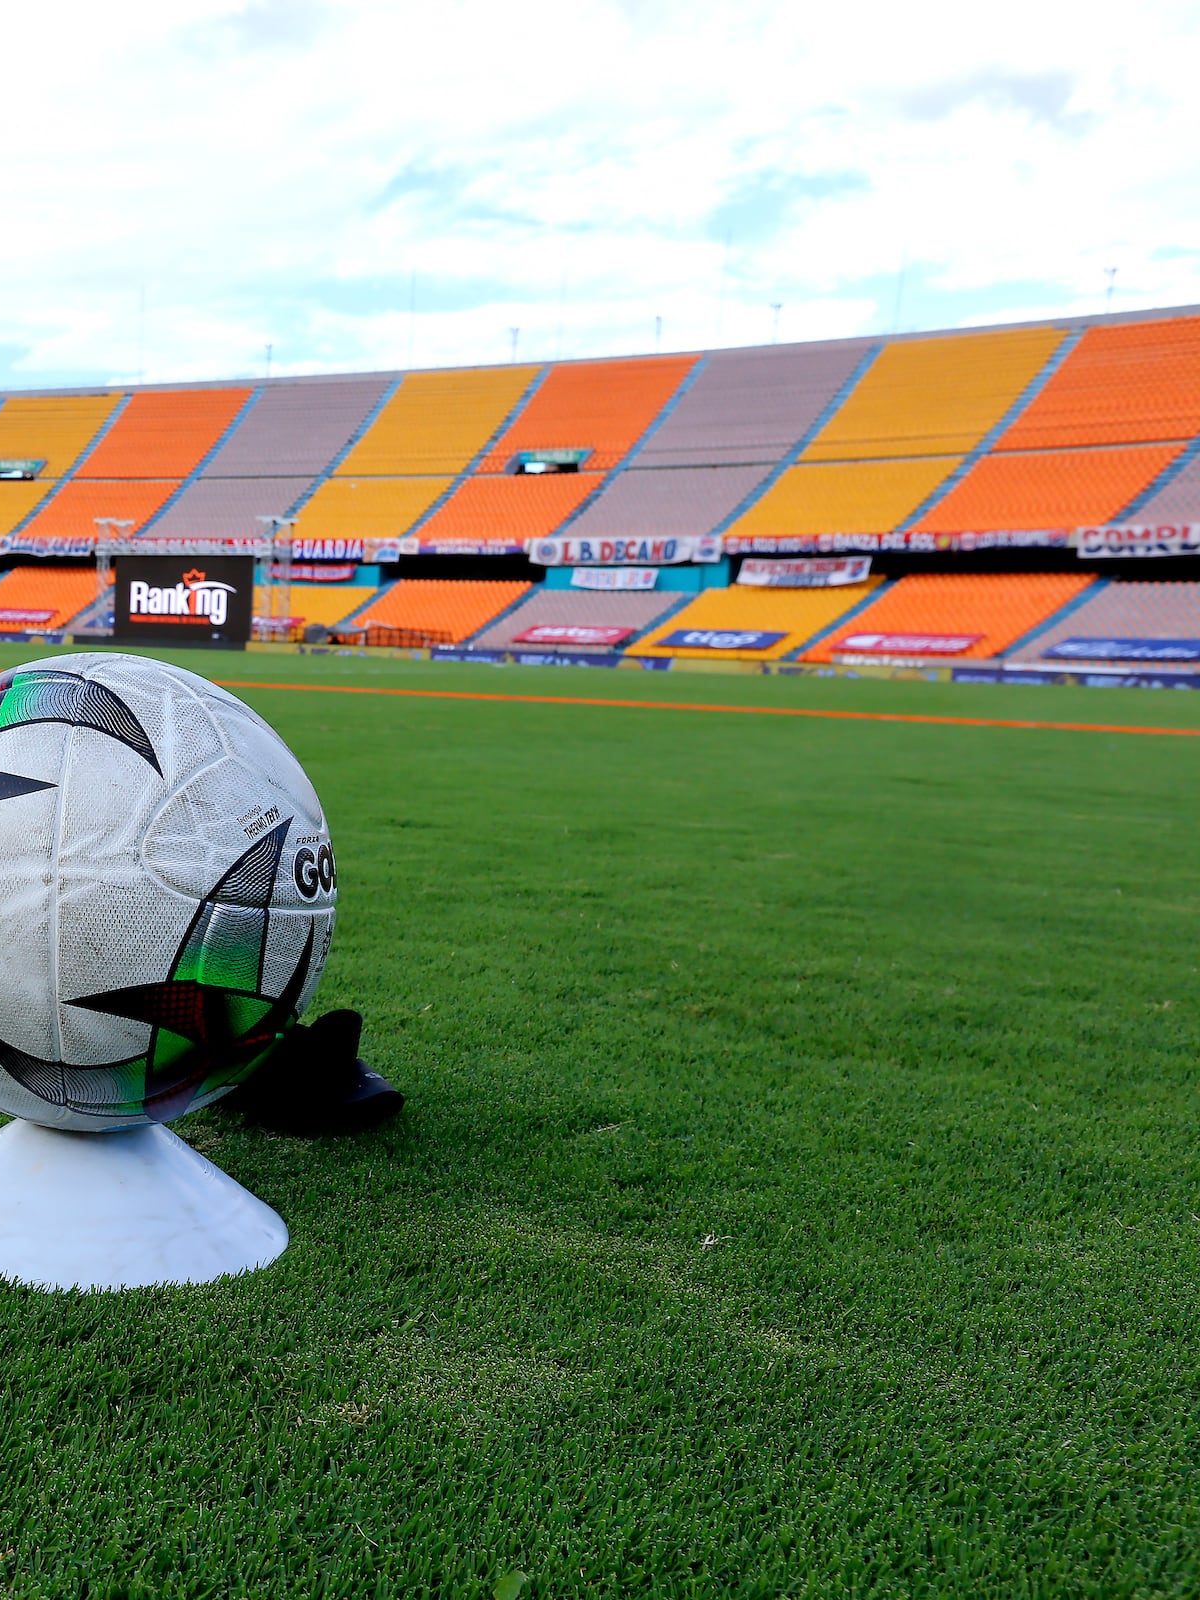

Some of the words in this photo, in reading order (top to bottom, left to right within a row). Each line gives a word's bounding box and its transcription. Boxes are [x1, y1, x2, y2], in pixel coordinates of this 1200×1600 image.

[292, 539, 366, 559] GUARDIA
[600, 539, 677, 561] DECANO
[129, 570, 230, 626] Ranking
